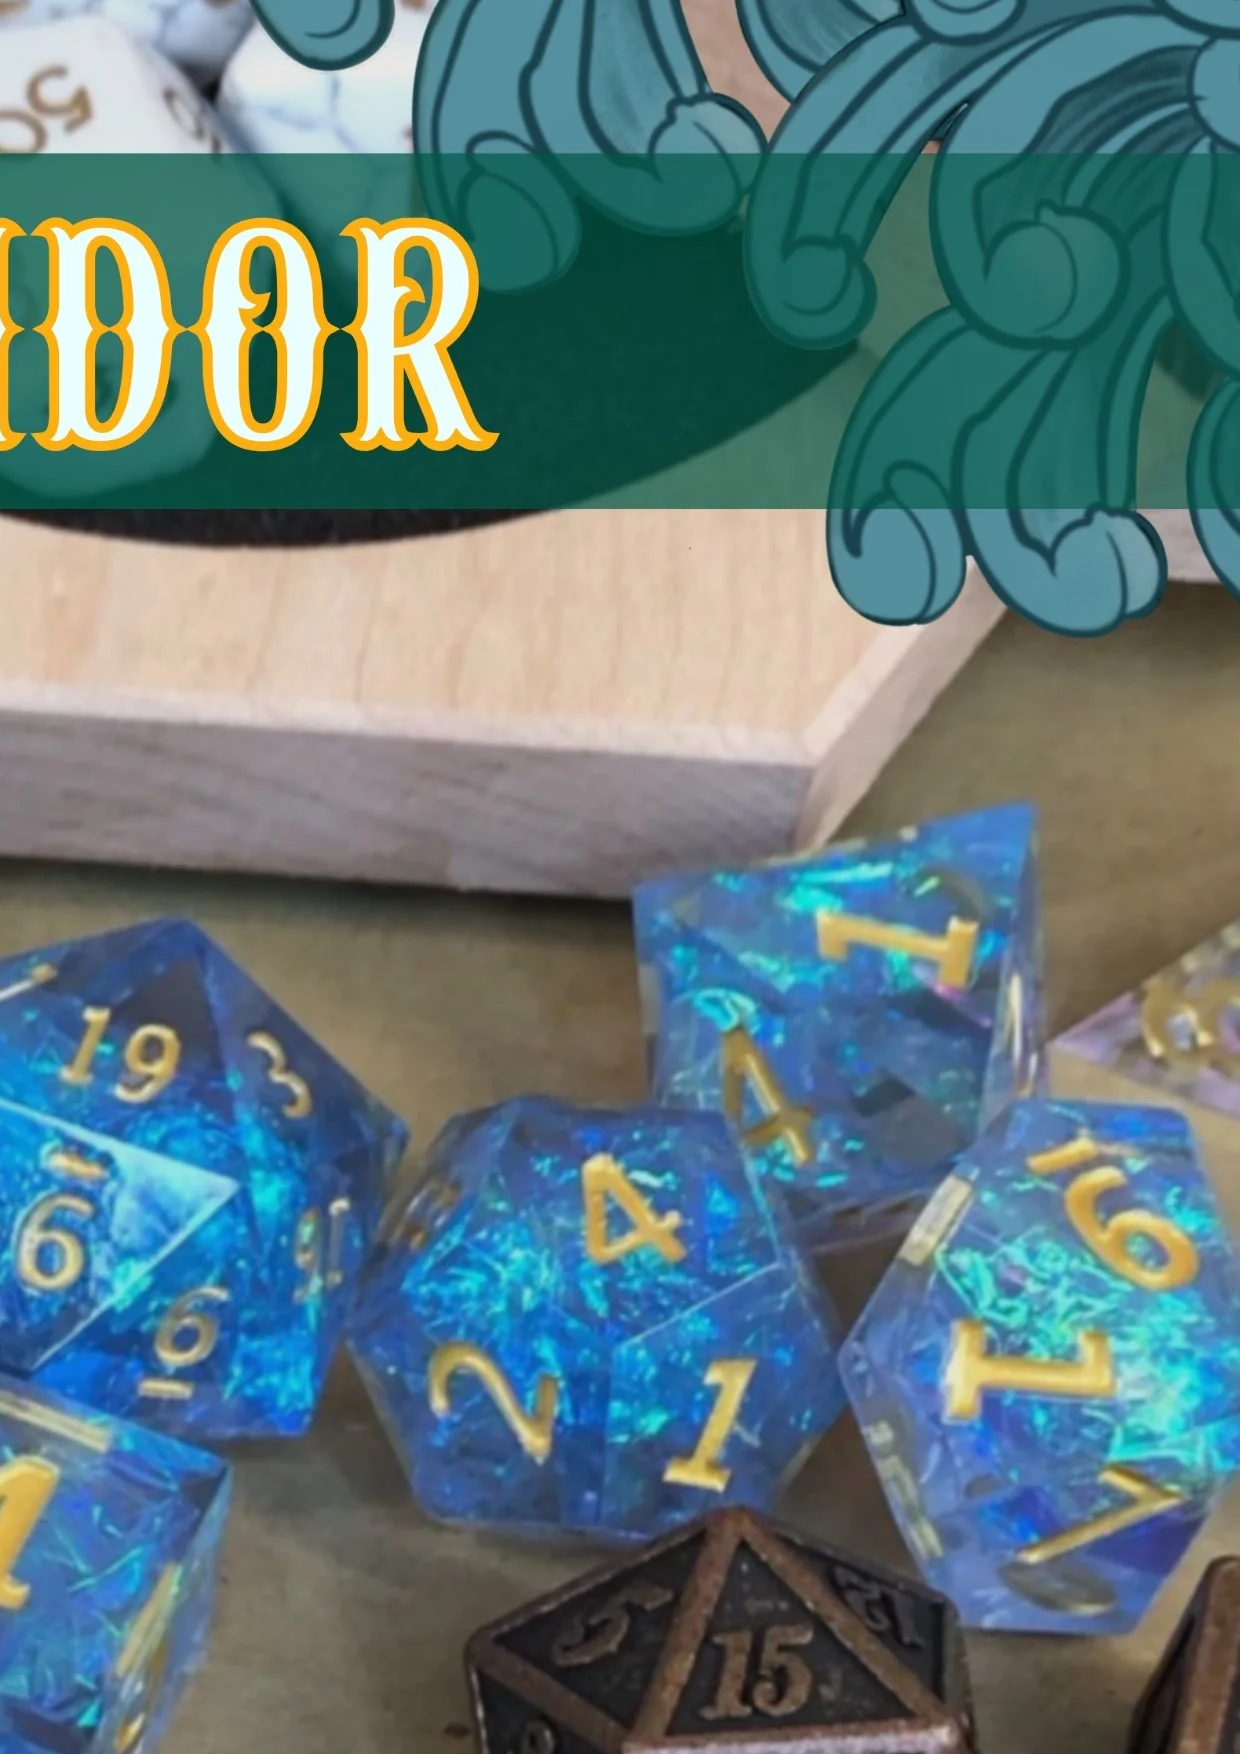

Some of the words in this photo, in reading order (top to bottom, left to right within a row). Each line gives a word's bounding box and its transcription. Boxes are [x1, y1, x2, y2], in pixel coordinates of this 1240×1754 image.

[816, 908, 979, 988] 1
[60, 1006, 182, 1103] 19
[248, 1032, 312, 1118] 3
[723, 1025, 816, 1166] 4
[581, 1153, 688, 1265] 4
[427, 1342, 558, 1465] 2
[942, 1318, 1118, 1424] 1
[662, 1358, 756, 1493] 1
[698, 1625, 816, 1721] 15
